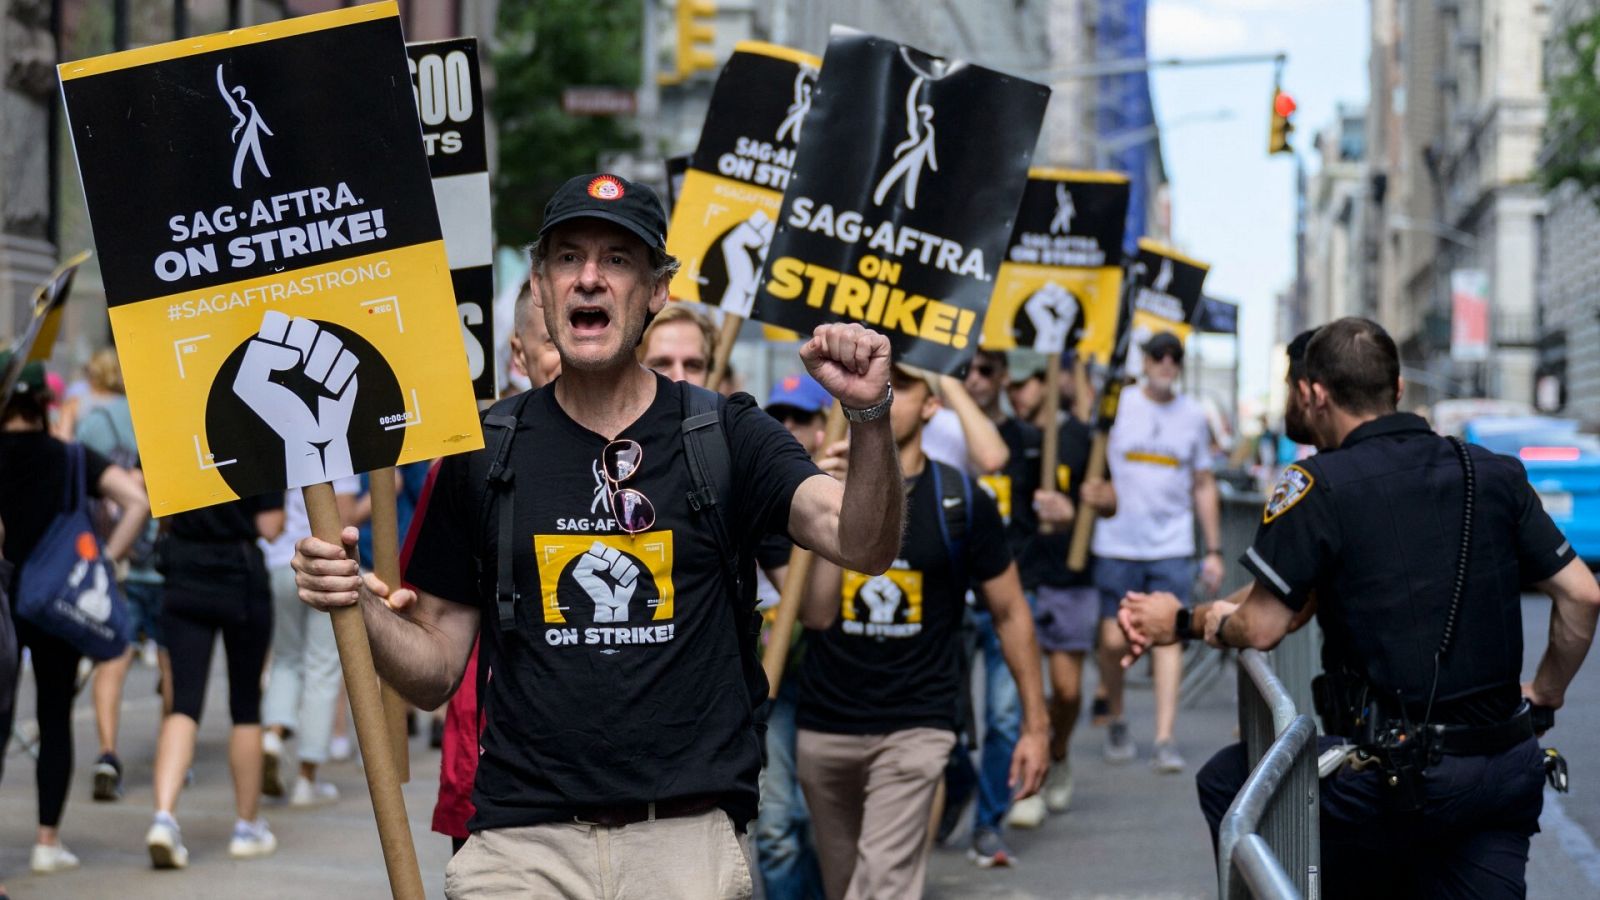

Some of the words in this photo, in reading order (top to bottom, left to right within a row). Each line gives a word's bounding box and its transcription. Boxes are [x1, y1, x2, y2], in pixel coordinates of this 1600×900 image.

[408, 50, 473, 126] 00
[718, 152, 755, 181] ON
[154, 243, 219, 282] ON
[228, 208, 387, 268] STRIKE!
[858, 254, 902, 285] ON
[167, 260, 391, 321] #SAGAFTRASTRONG
[766, 256, 976, 349] STRIKE!
[545, 628, 578, 646] ON
[584, 624, 675, 645] STRIKE!
